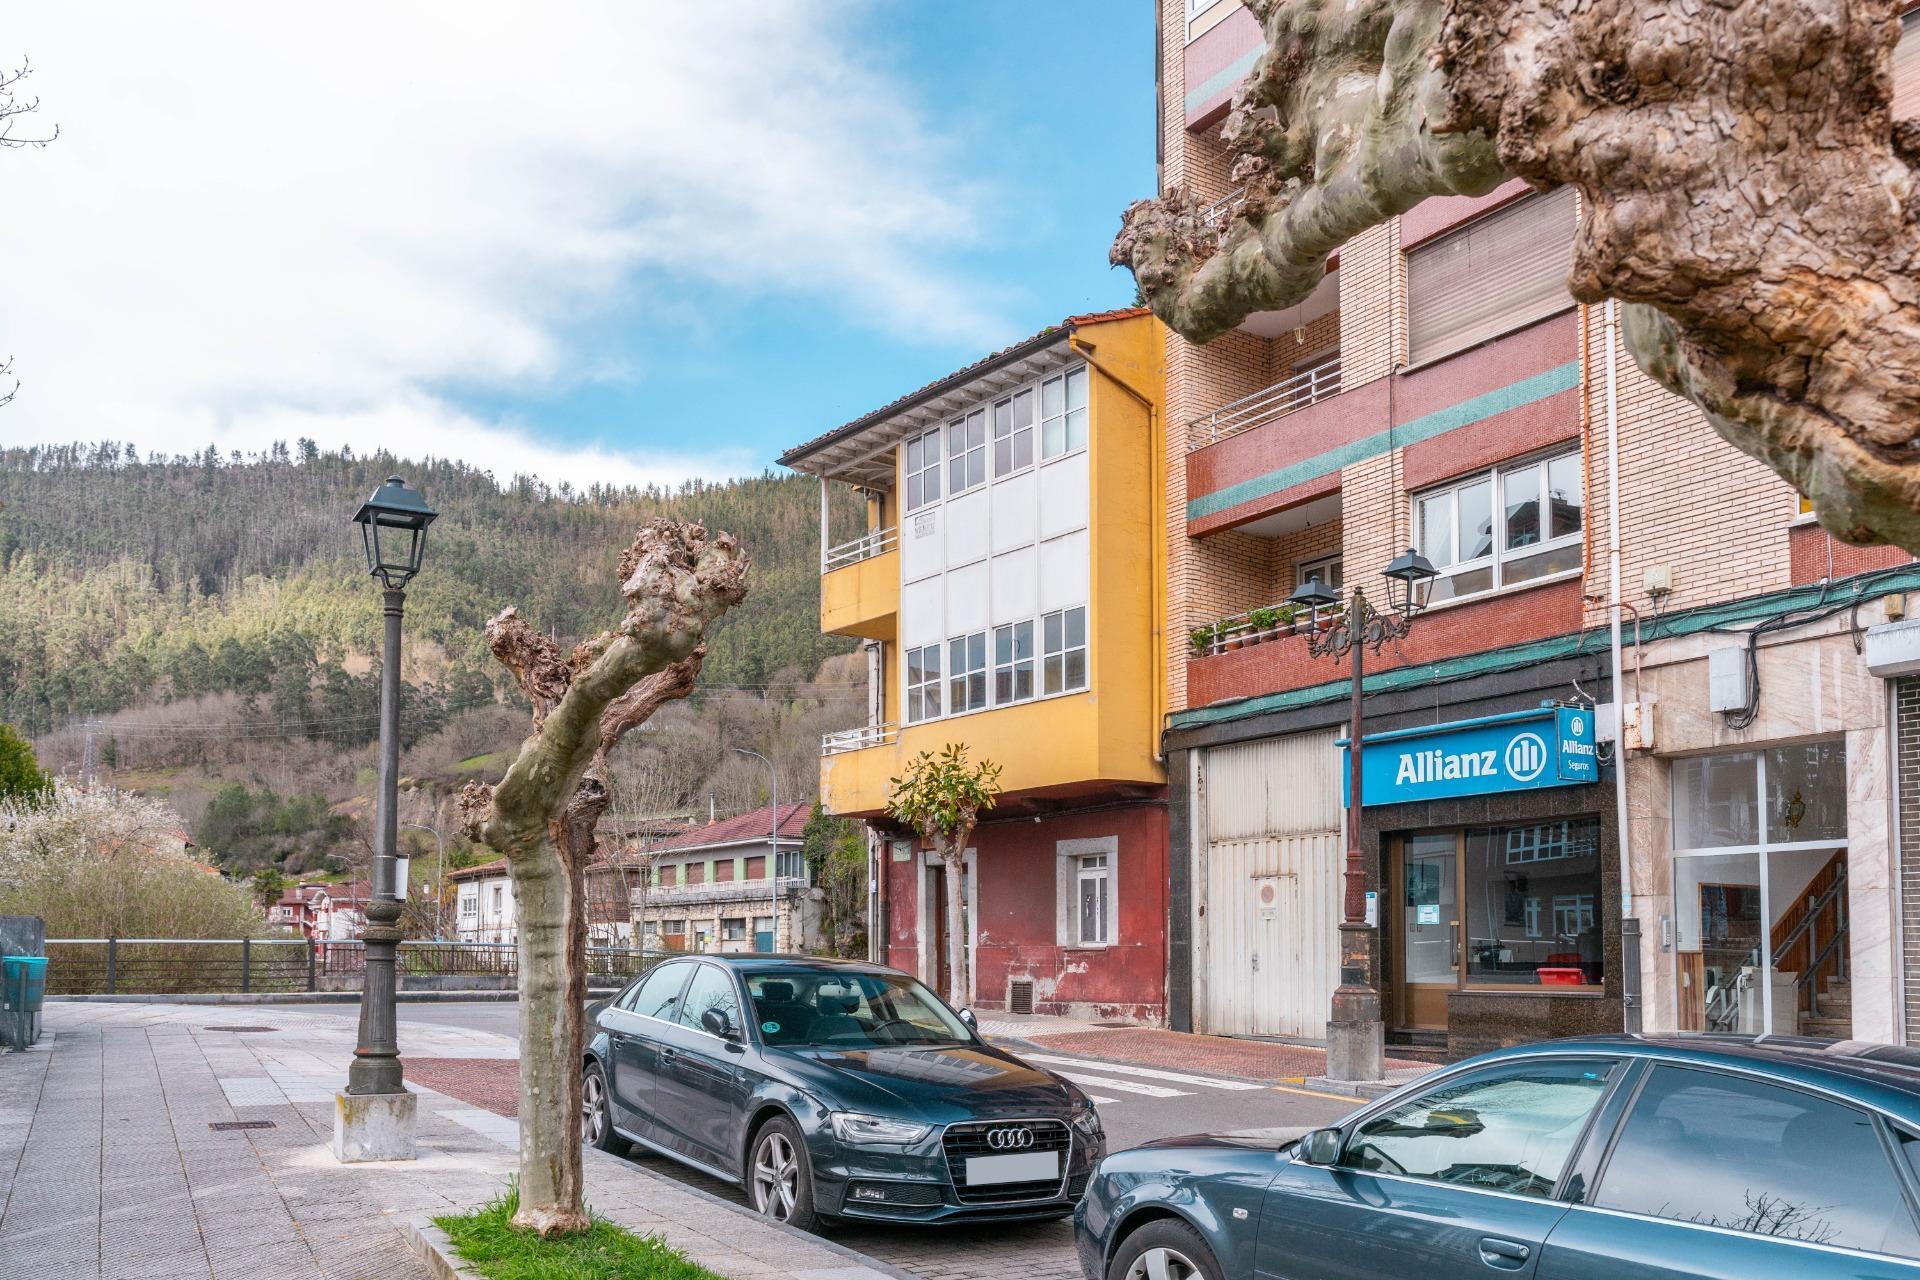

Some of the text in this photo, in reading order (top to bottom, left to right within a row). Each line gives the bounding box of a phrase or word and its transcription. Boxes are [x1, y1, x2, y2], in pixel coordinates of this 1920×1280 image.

[1562, 739, 1594, 755] Allianz
[1395, 749, 1497, 785] Allianz
[1568, 759, 1590, 771] Seguros
